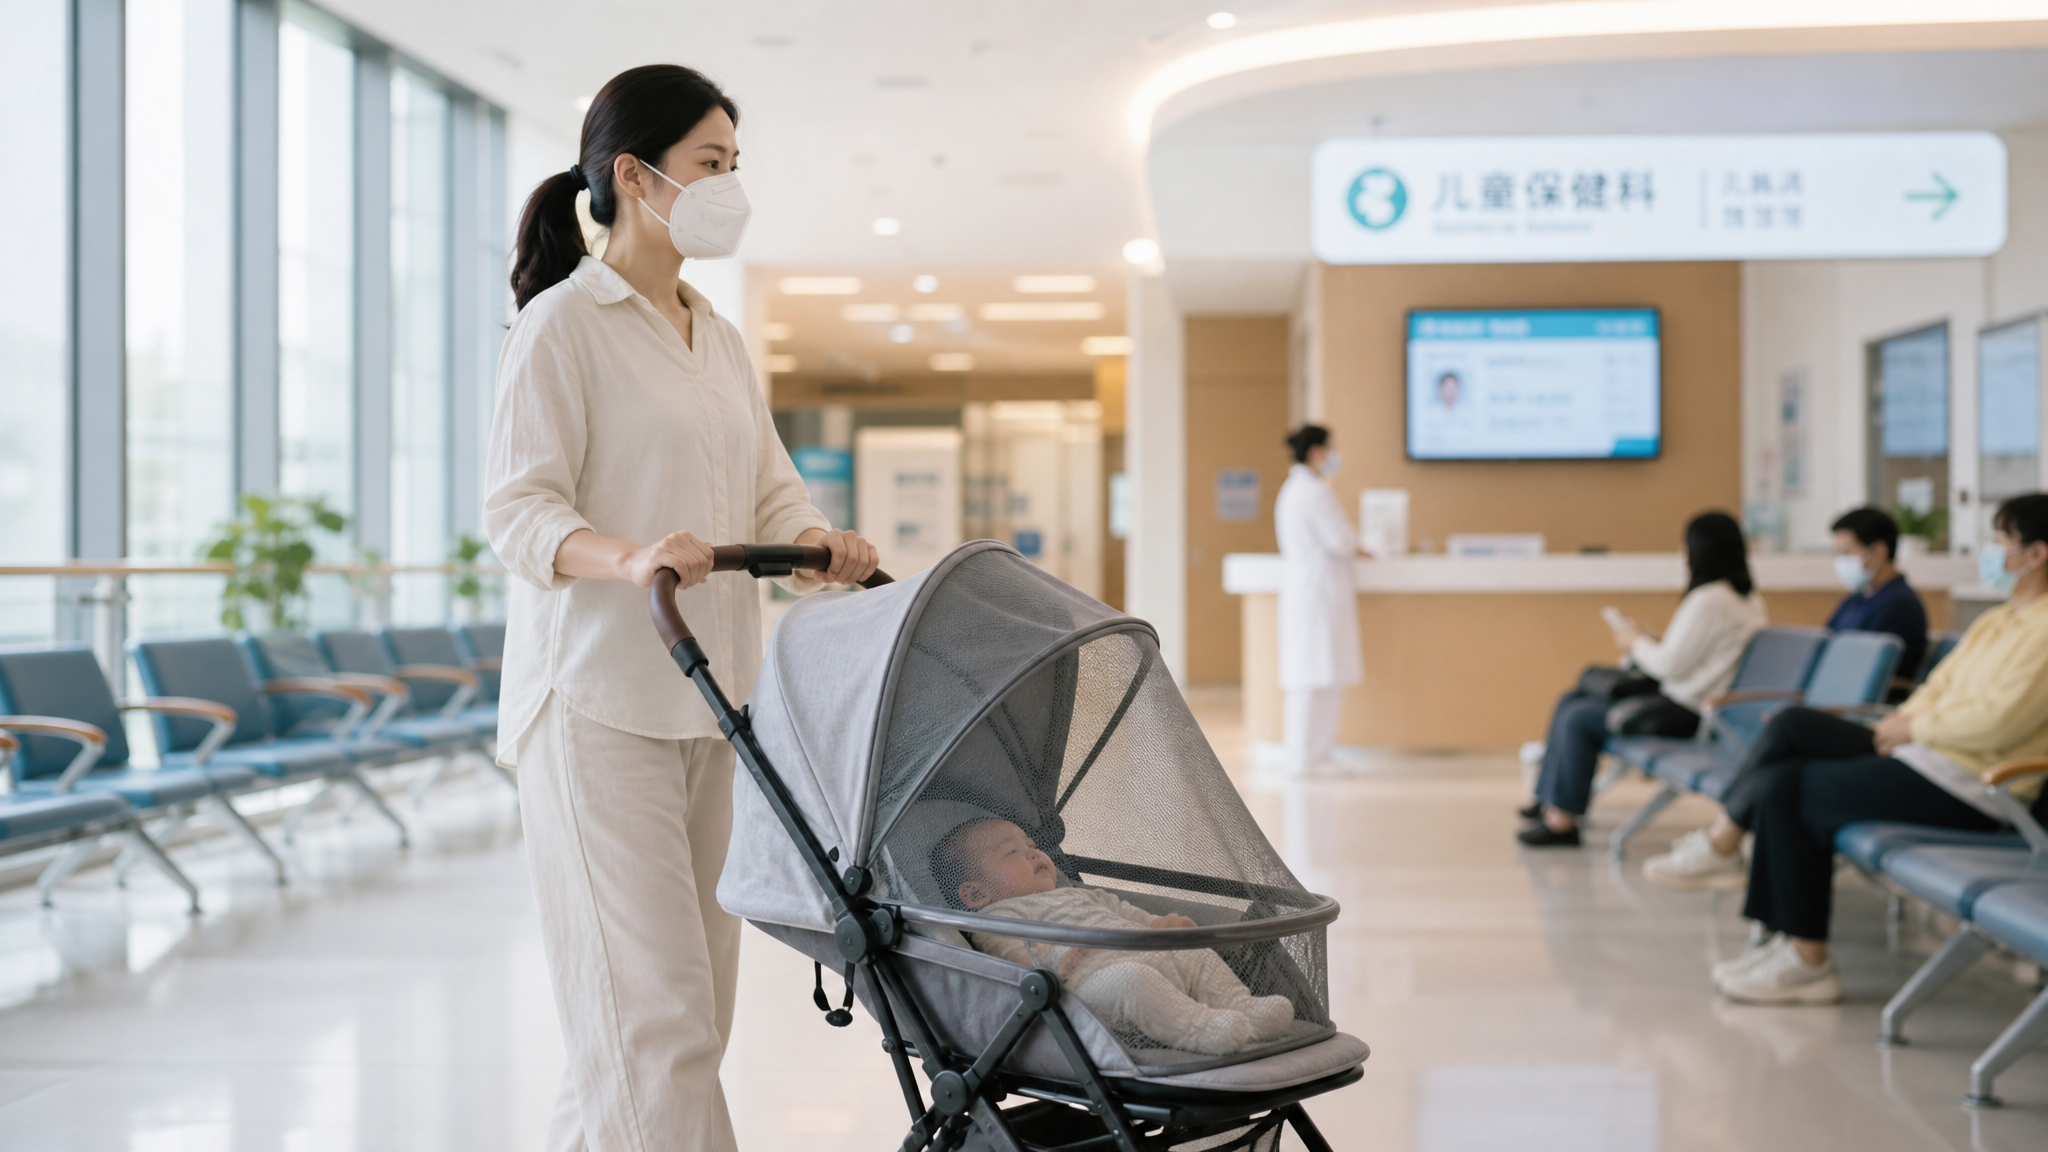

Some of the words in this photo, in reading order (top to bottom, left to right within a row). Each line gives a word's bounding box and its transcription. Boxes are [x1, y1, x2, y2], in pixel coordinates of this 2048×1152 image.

[1432, 170, 1656, 211] 儿童保健科
